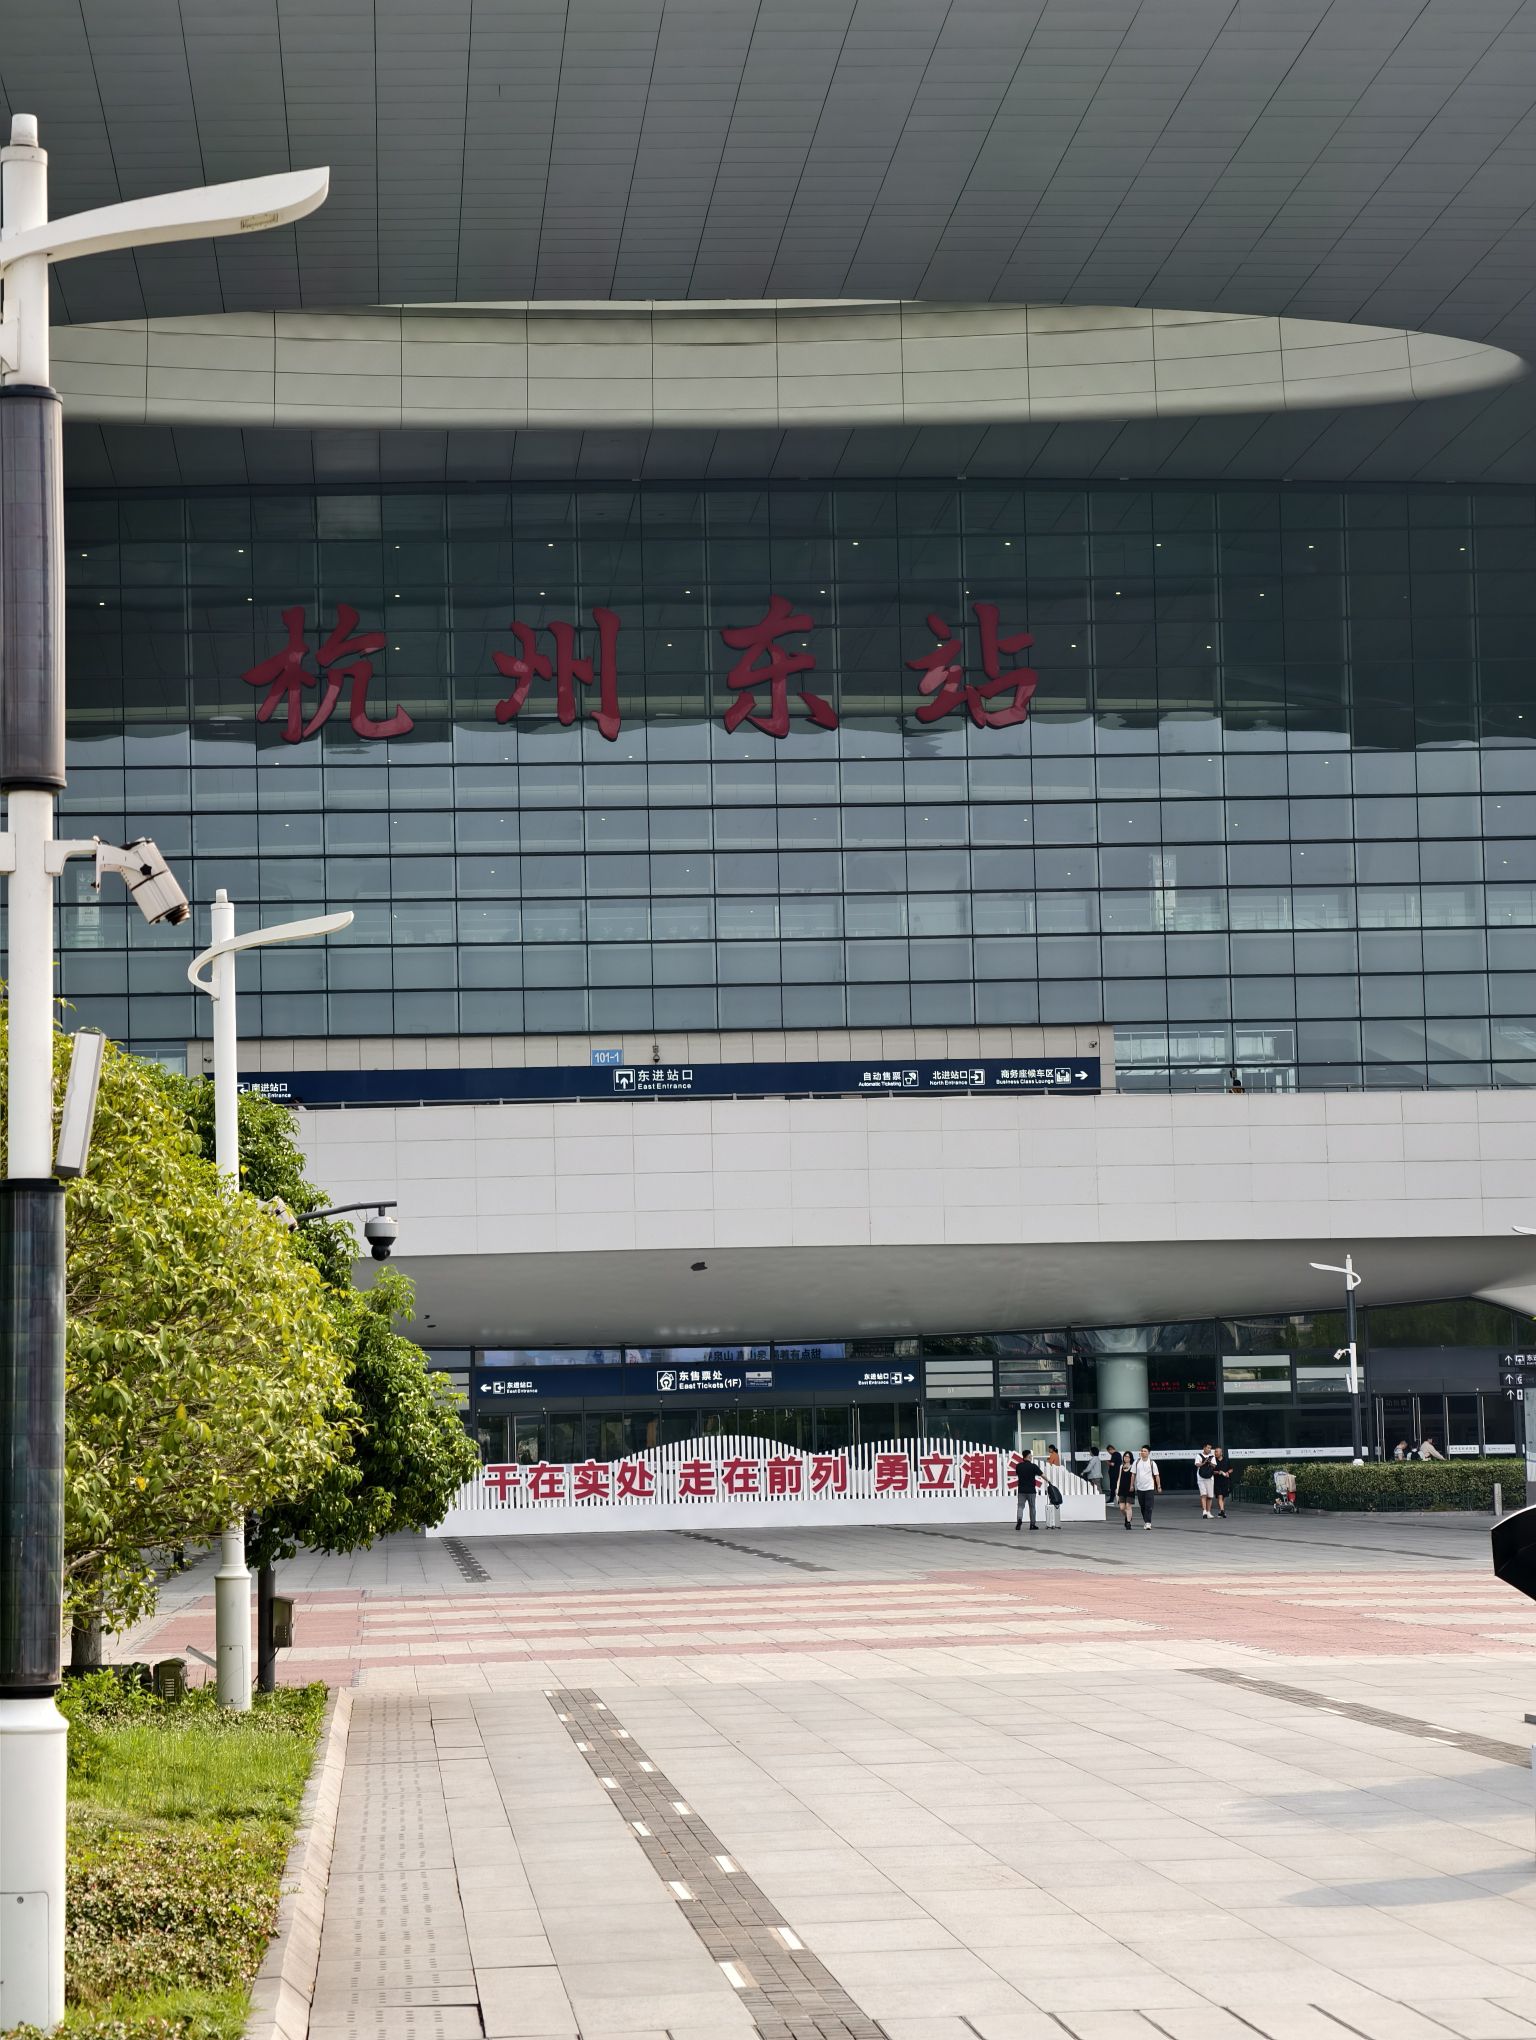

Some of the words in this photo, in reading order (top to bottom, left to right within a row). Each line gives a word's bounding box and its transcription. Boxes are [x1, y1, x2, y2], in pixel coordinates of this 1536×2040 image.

[242, 594, 1038, 745] 杭州东站
[594, 1051, 620, 1064] 101-1
[637, 1069, 693, 1082] 东进站口
[863, 1071, 902, 1081] 自动售票
[932, 1070, 968, 1080] 北进站口
[1000, 1068, 1054, 1079] 商务座候车区
[252, 1083, 288, 1092] 南进站口
[656, 1082, 692, 1090] Entrance
[678, 1370, 723, 1381] 东售票处
[679, 1382, 696, 1390] East
[696, 1381, 724, 1389] Tickets
[724, 1378, 742, 1389] (1F)
[484, 1459, 655, 1502] 干在实处
[679, 1454, 848, 1497] 走在前列
